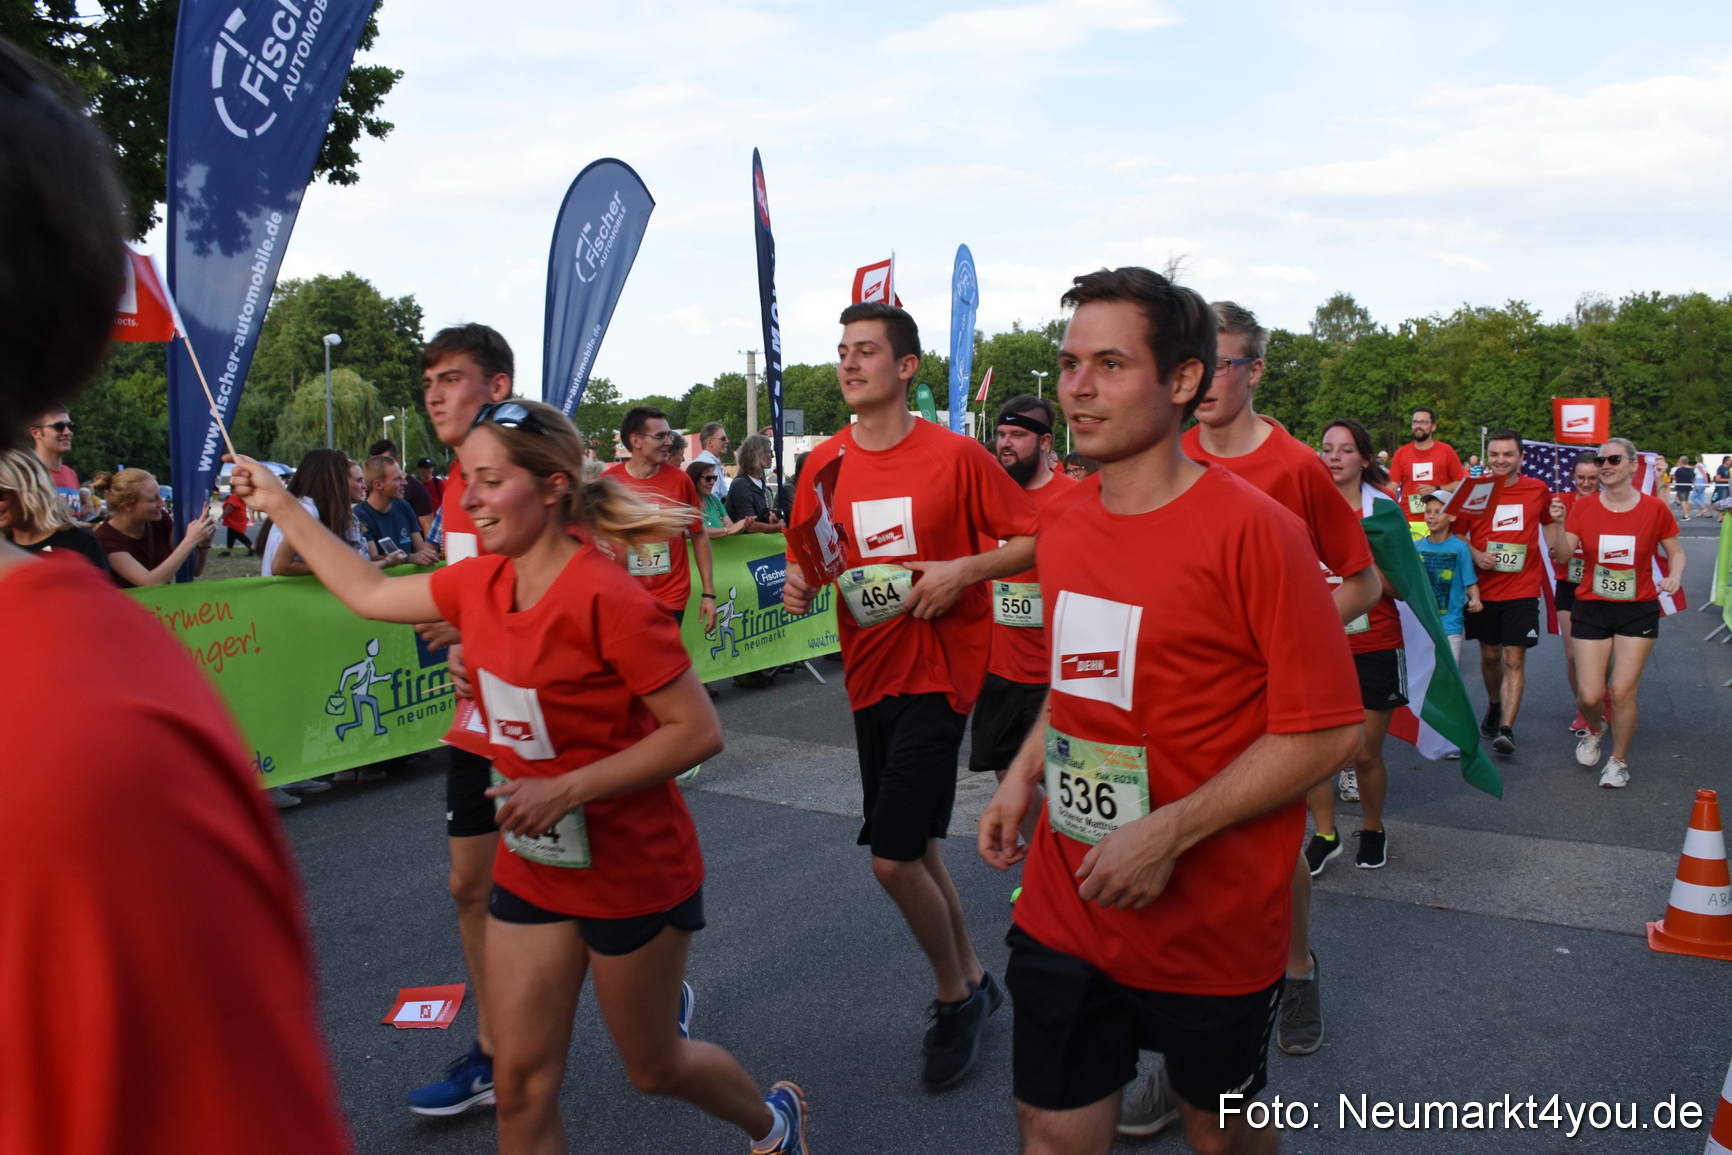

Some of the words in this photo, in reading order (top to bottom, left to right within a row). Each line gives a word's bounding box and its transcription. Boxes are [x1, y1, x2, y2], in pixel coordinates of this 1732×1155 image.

[585, 190, 622, 269] Fischer
[599, 204, 627, 269] AUTOMOBILE
[198, 211, 283, 472] wwwfischer-automobile.de
[1495, 553, 1518, 565] 502
[861, 582, 900, 609] 464
[1601, 578, 1627, 592] 538
[1002, 598, 1031, 615] 550
[744, 629, 786, 651] neumarkt
[1076, 659, 1105, 672] DEHN
[1059, 771, 1118, 820] 536
